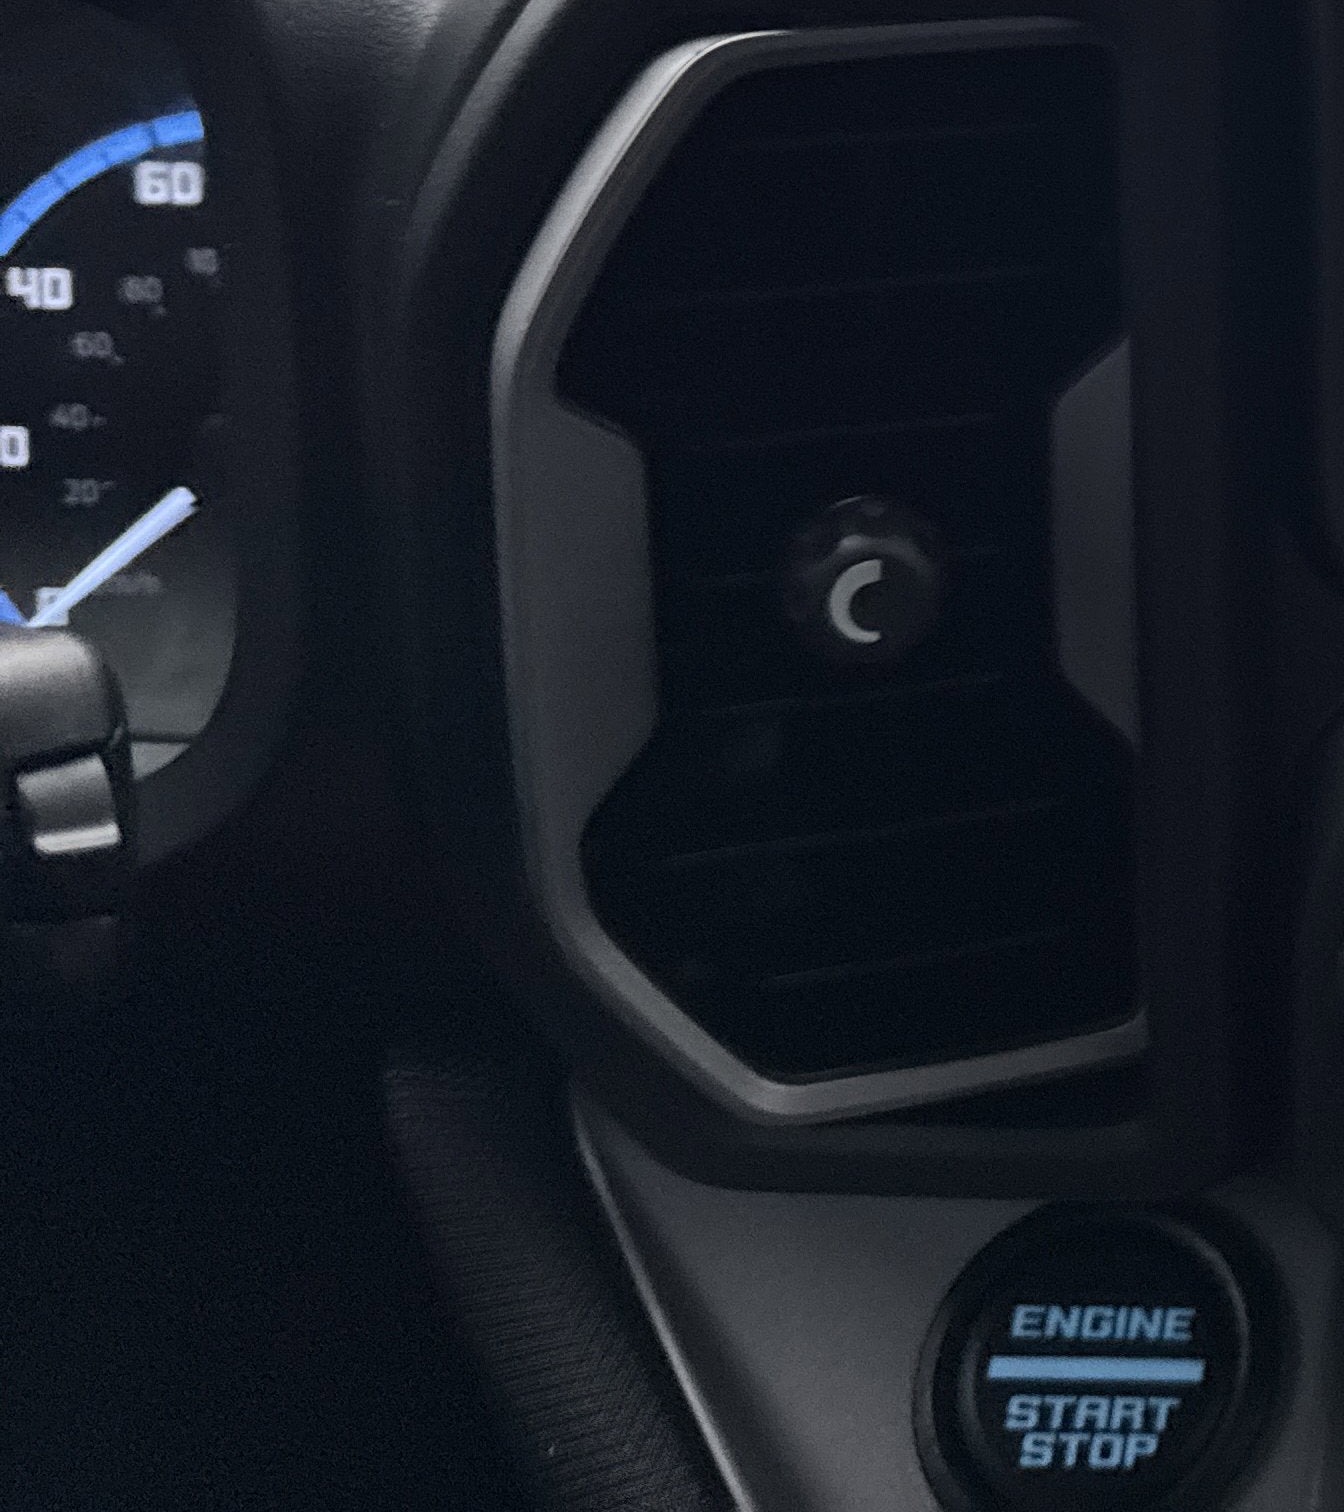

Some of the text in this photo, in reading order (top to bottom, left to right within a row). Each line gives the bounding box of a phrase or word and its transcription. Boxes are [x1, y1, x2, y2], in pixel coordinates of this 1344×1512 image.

[135, 161, 205, 206] 60
[6, 266, 73, 311] 40
[1011, 1304, 1196, 1341] ENGINE
[1004, 1394, 1180, 1432] START
[1020, 1433, 1158, 1468] STOP
